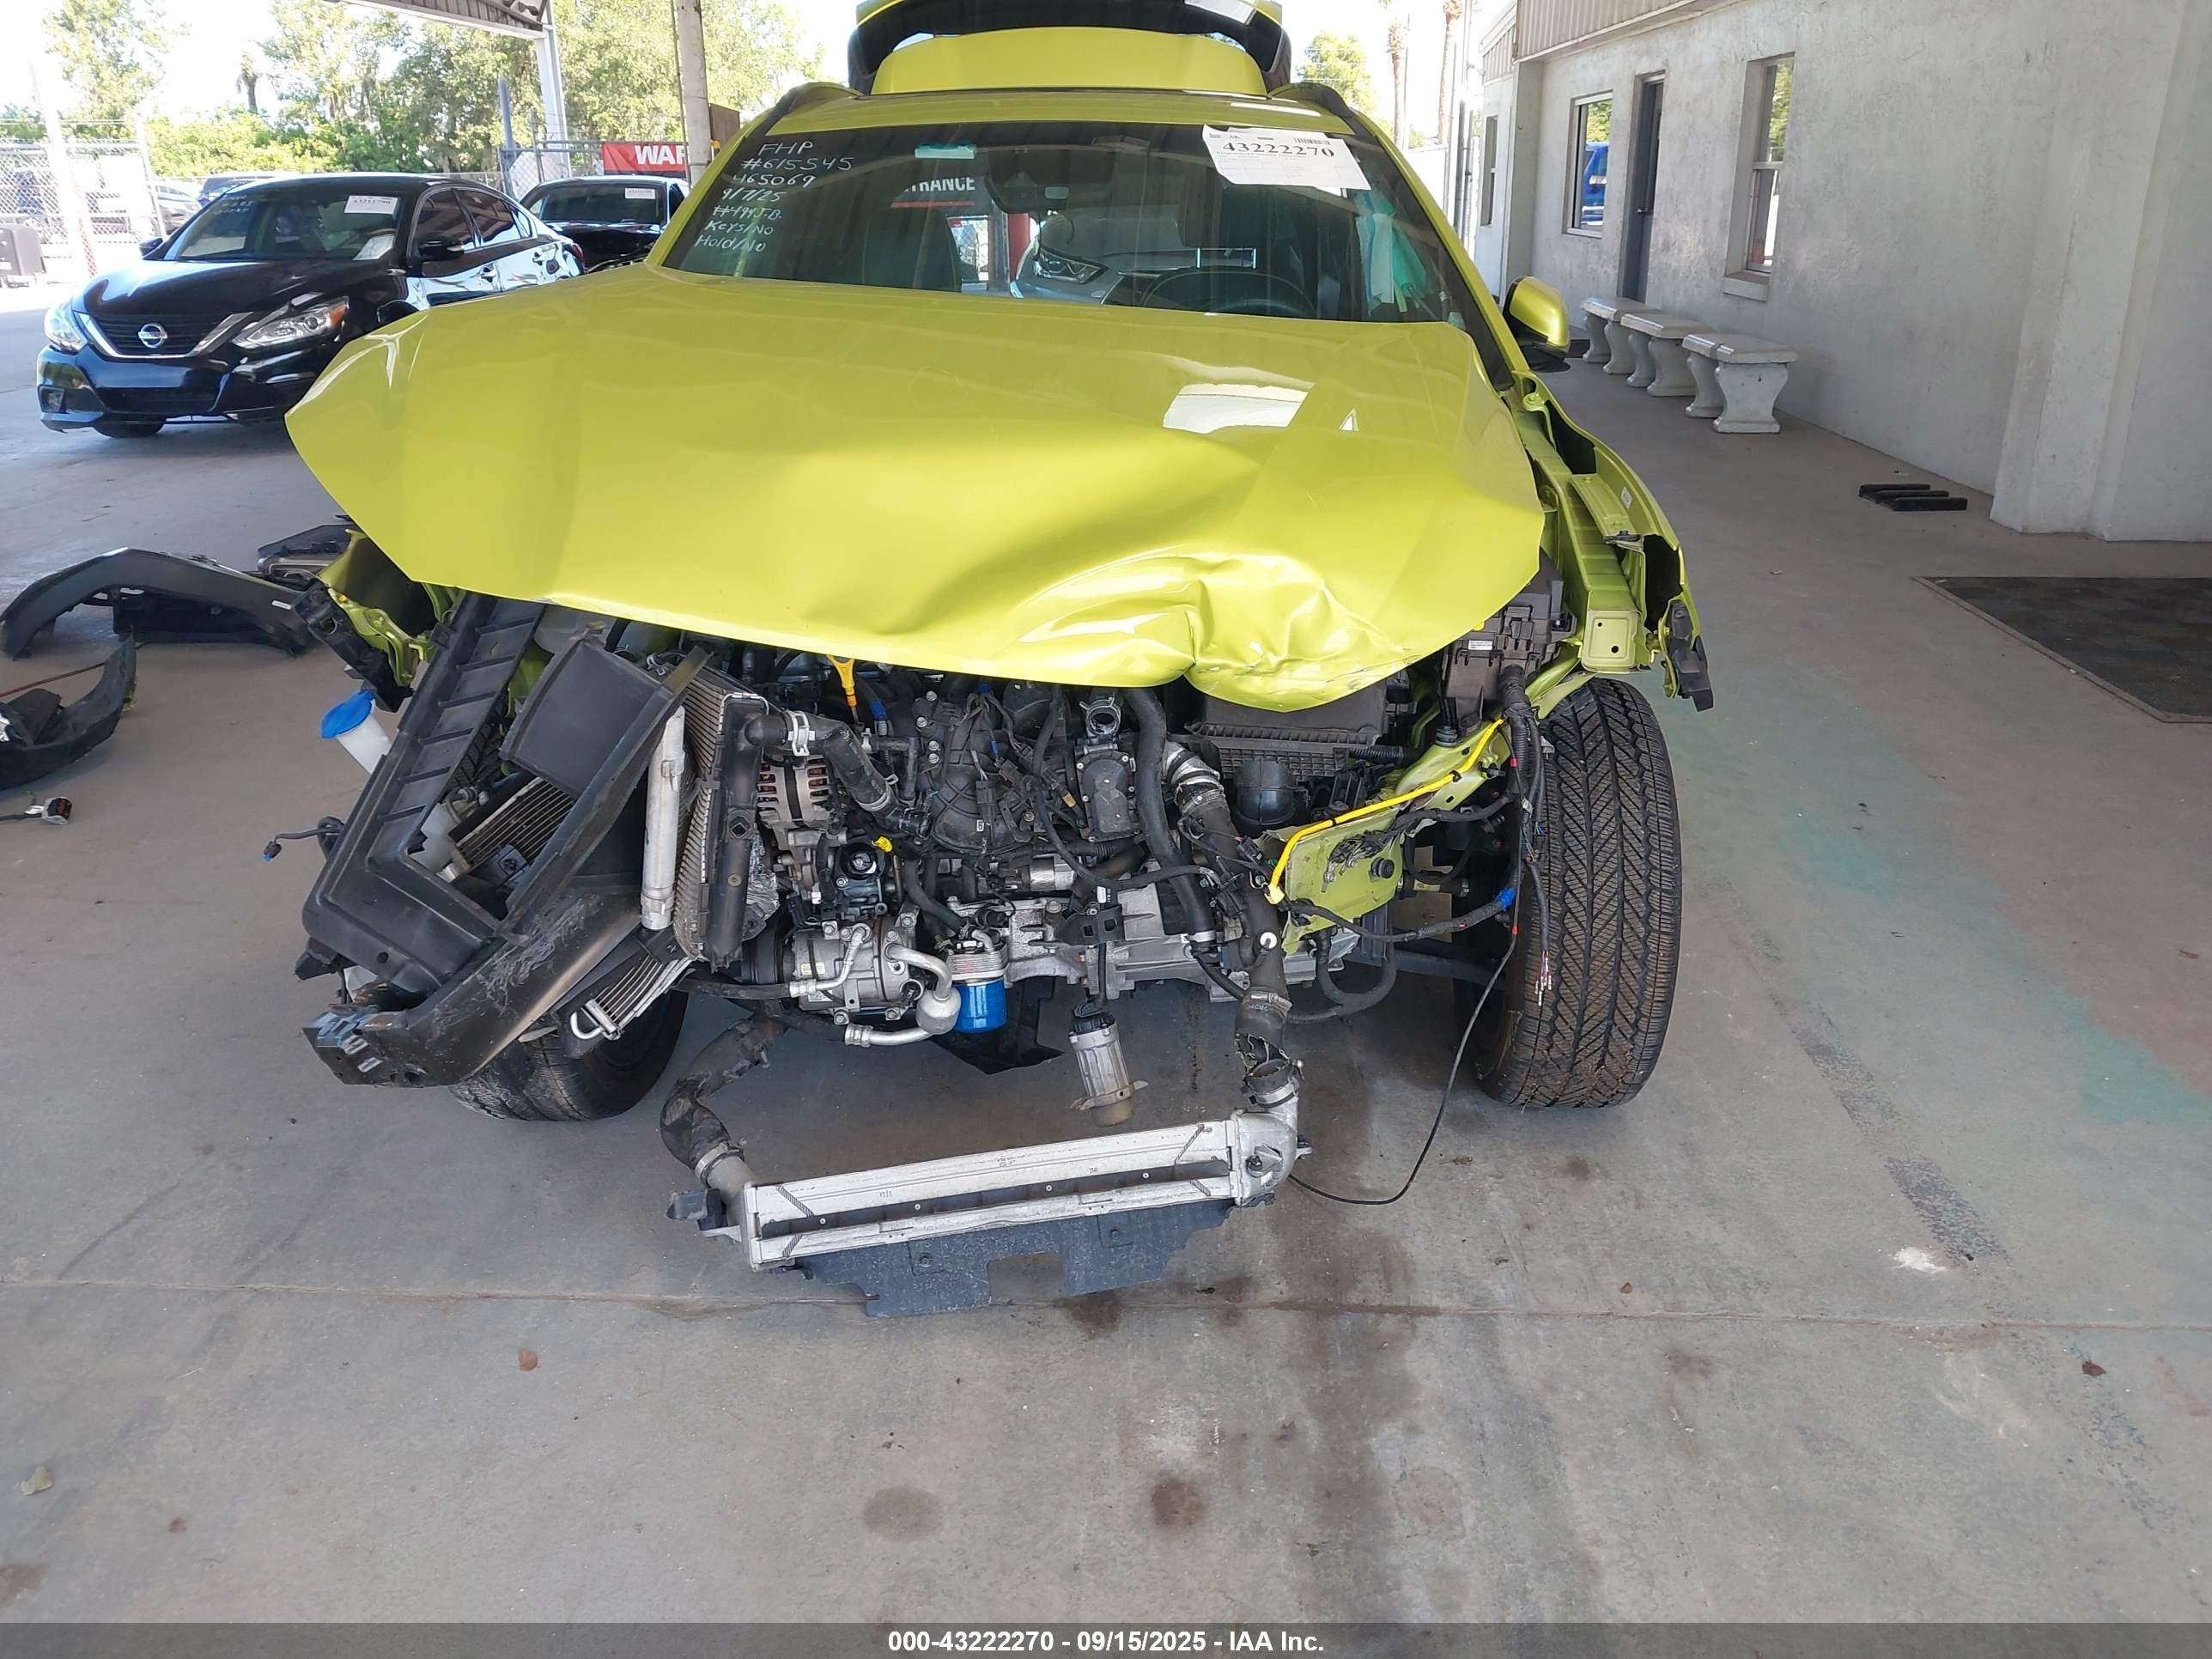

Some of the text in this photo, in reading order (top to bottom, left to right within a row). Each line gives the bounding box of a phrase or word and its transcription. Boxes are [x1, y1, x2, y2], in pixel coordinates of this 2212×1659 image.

[757, 140, 814, 156] FHP
[1222, 142, 1335, 158] 43222270
[740, 157, 855, 171] #615545
[732, 173, 817, 188] 465069
[722, 187, 788, 202] 9/7/25
